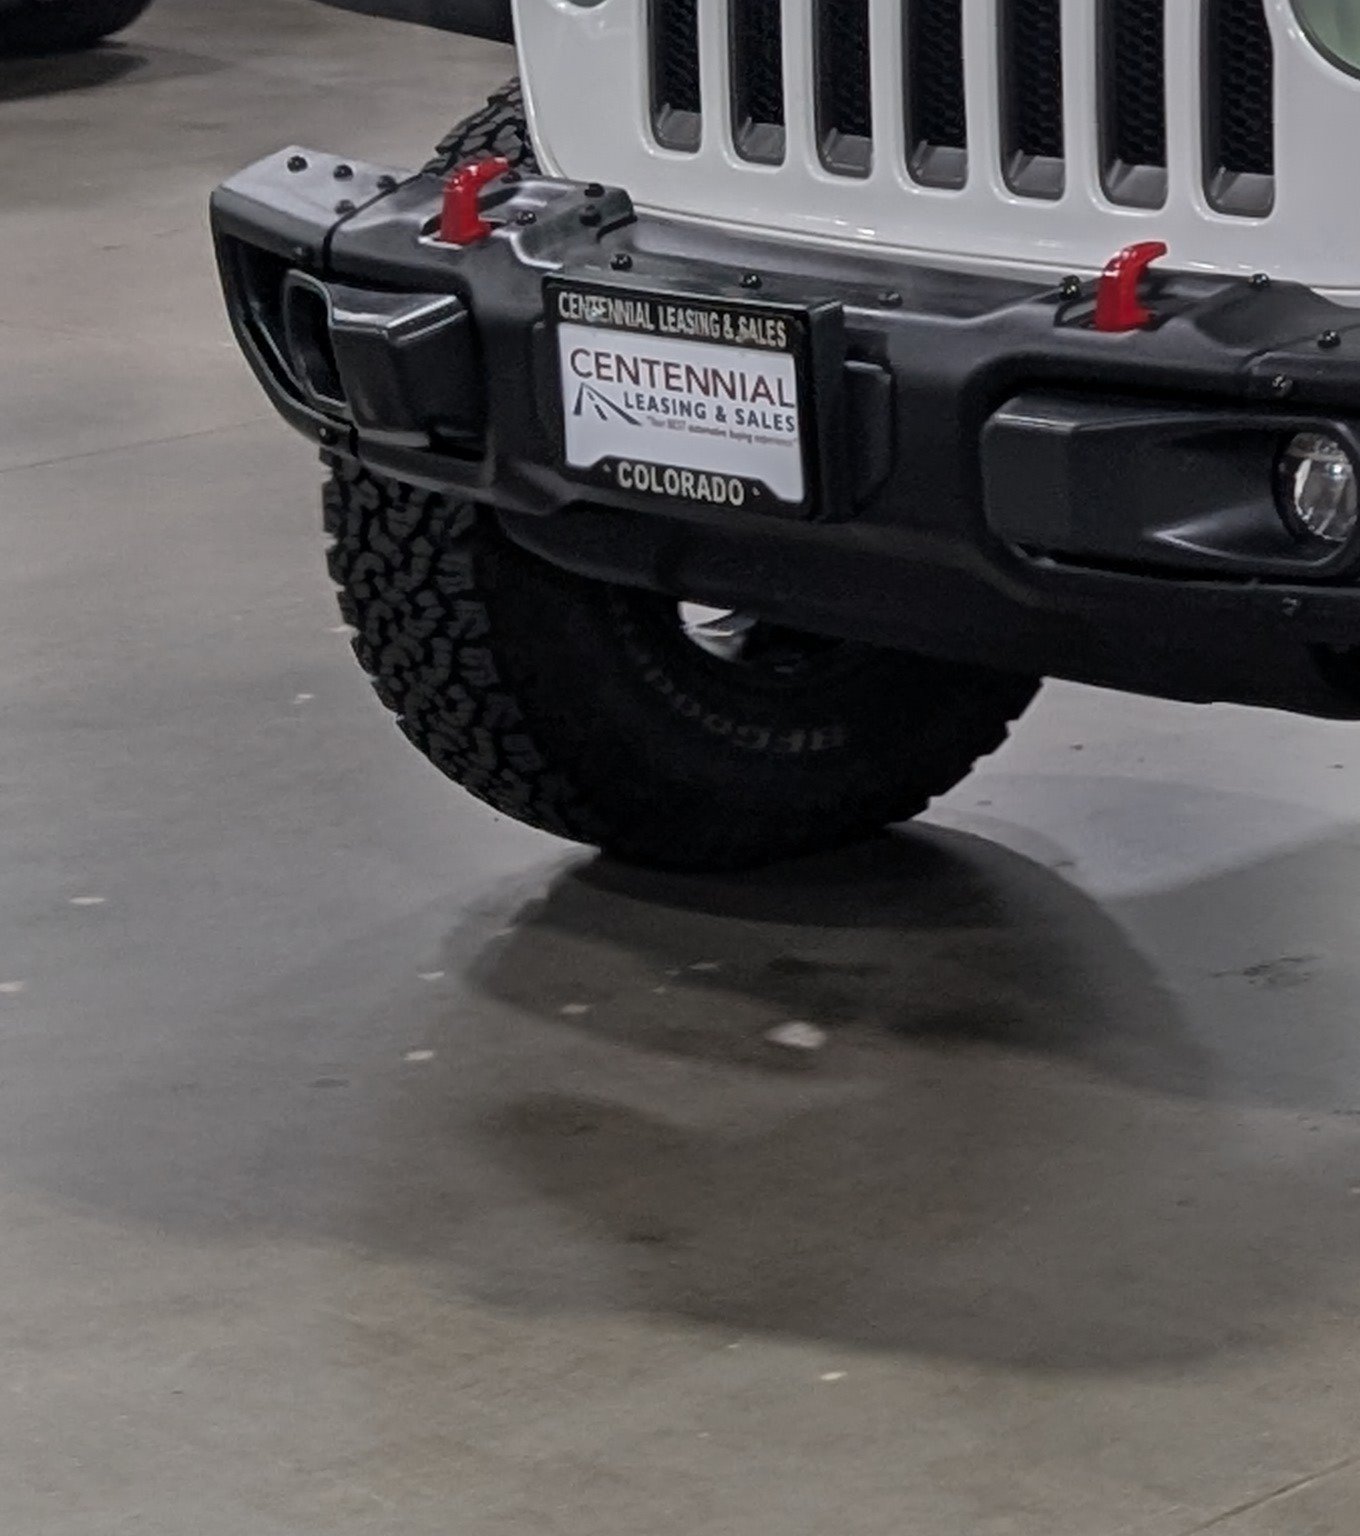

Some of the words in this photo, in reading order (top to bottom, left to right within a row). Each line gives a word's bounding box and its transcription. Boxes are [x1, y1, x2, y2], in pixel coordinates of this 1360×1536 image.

[558, 291, 655, 332] CENTENNIAL
[657, 305, 721, 339] LEASING
[722, 313, 735, 340] &
[735, 315, 787, 348] SALES
[570, 348, 796, 409] CENTENNIAL
[623, 390, 707, 421] LEASING
[715, 405, 727, 424] &
[735, 408, 796, 434] SALES
[617, 461, 745, 506] COLORADO
